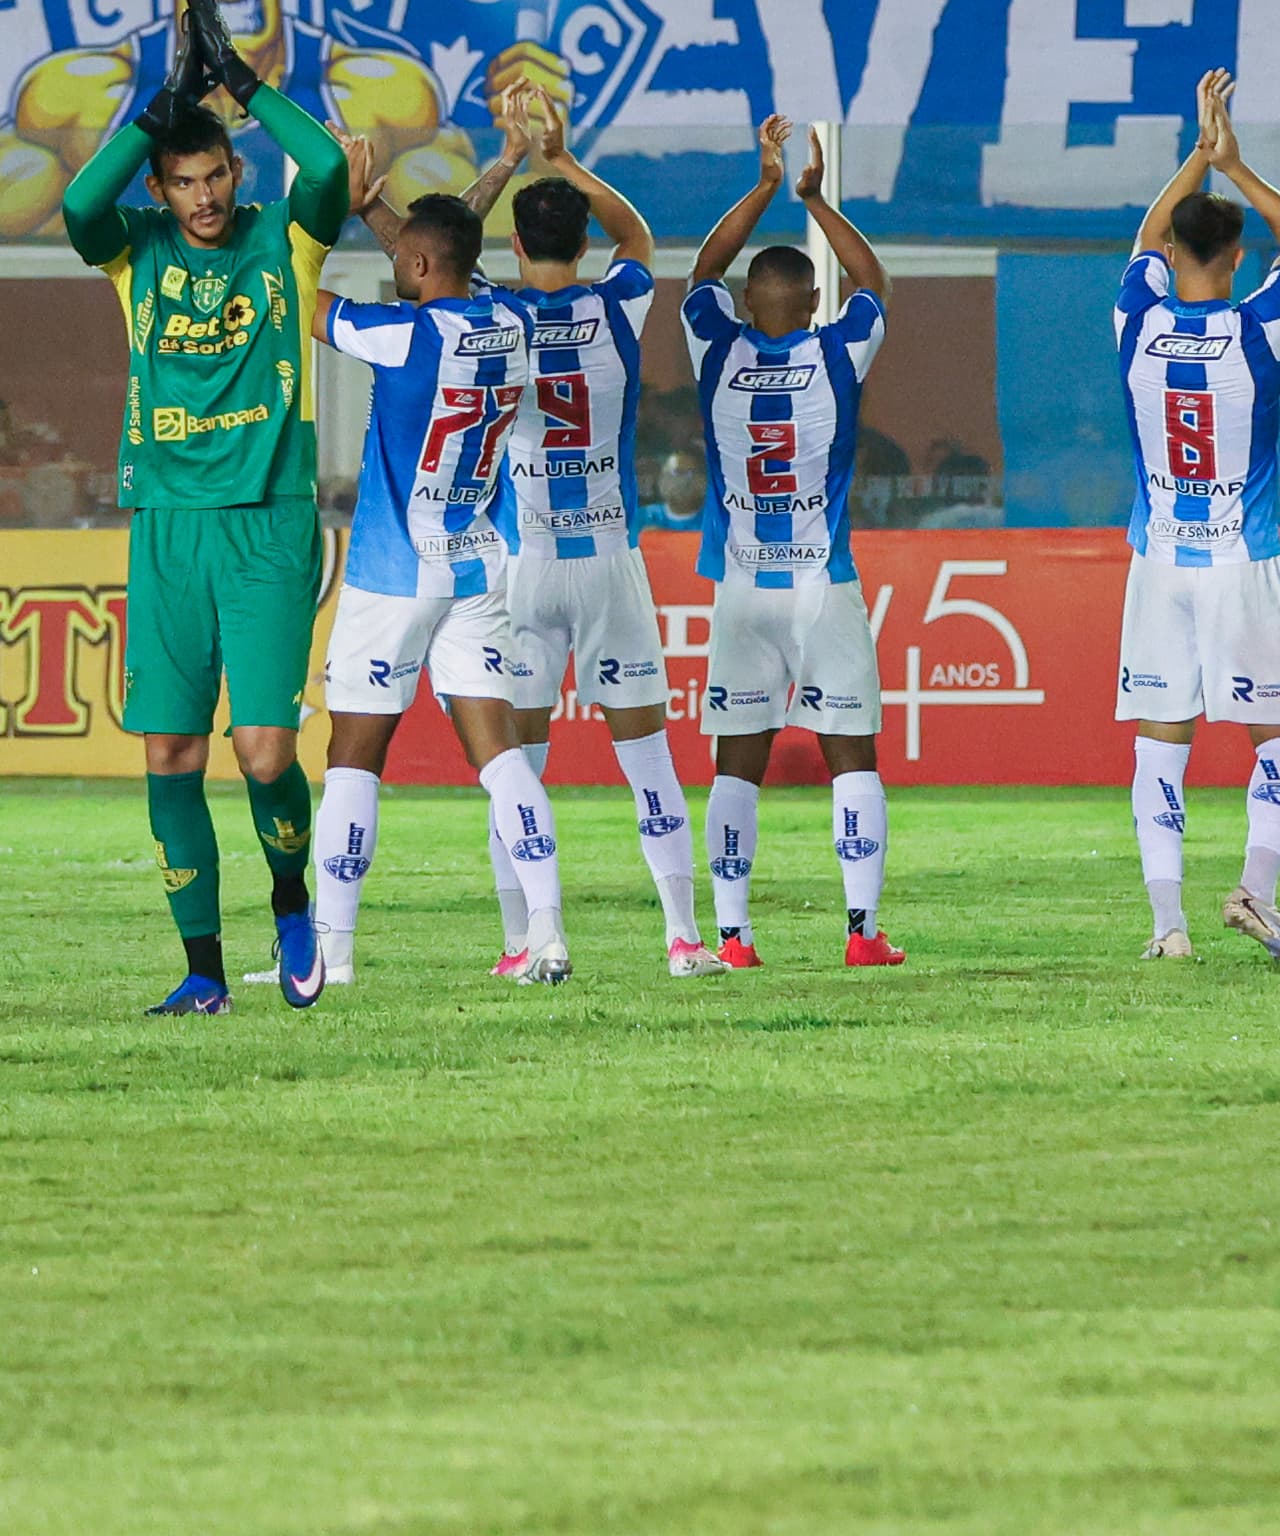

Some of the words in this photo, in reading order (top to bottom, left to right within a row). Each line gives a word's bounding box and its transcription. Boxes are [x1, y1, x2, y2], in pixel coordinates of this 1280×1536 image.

[164, 314, 220, 338] Bet
[182, 330, 250, 355] Sorte
[461, 328, 520, 354] GAZIN
[1155, 336, 1226, 358] GAZIN
[736, 367, 813, 390] GAZIN
[186, 403, 269, 433] Banpará
[532, 372, 593, 450] 9
[417, 385, 527, 481] 77
[1162, 388, 1219, 481] 8
[511, 455, 615, 478] ALUBAR
[745, 420, 799, 498] 2
[725, 493, 825, 514] ALUBAR
[928, 662, 1001, 688] ANOS
